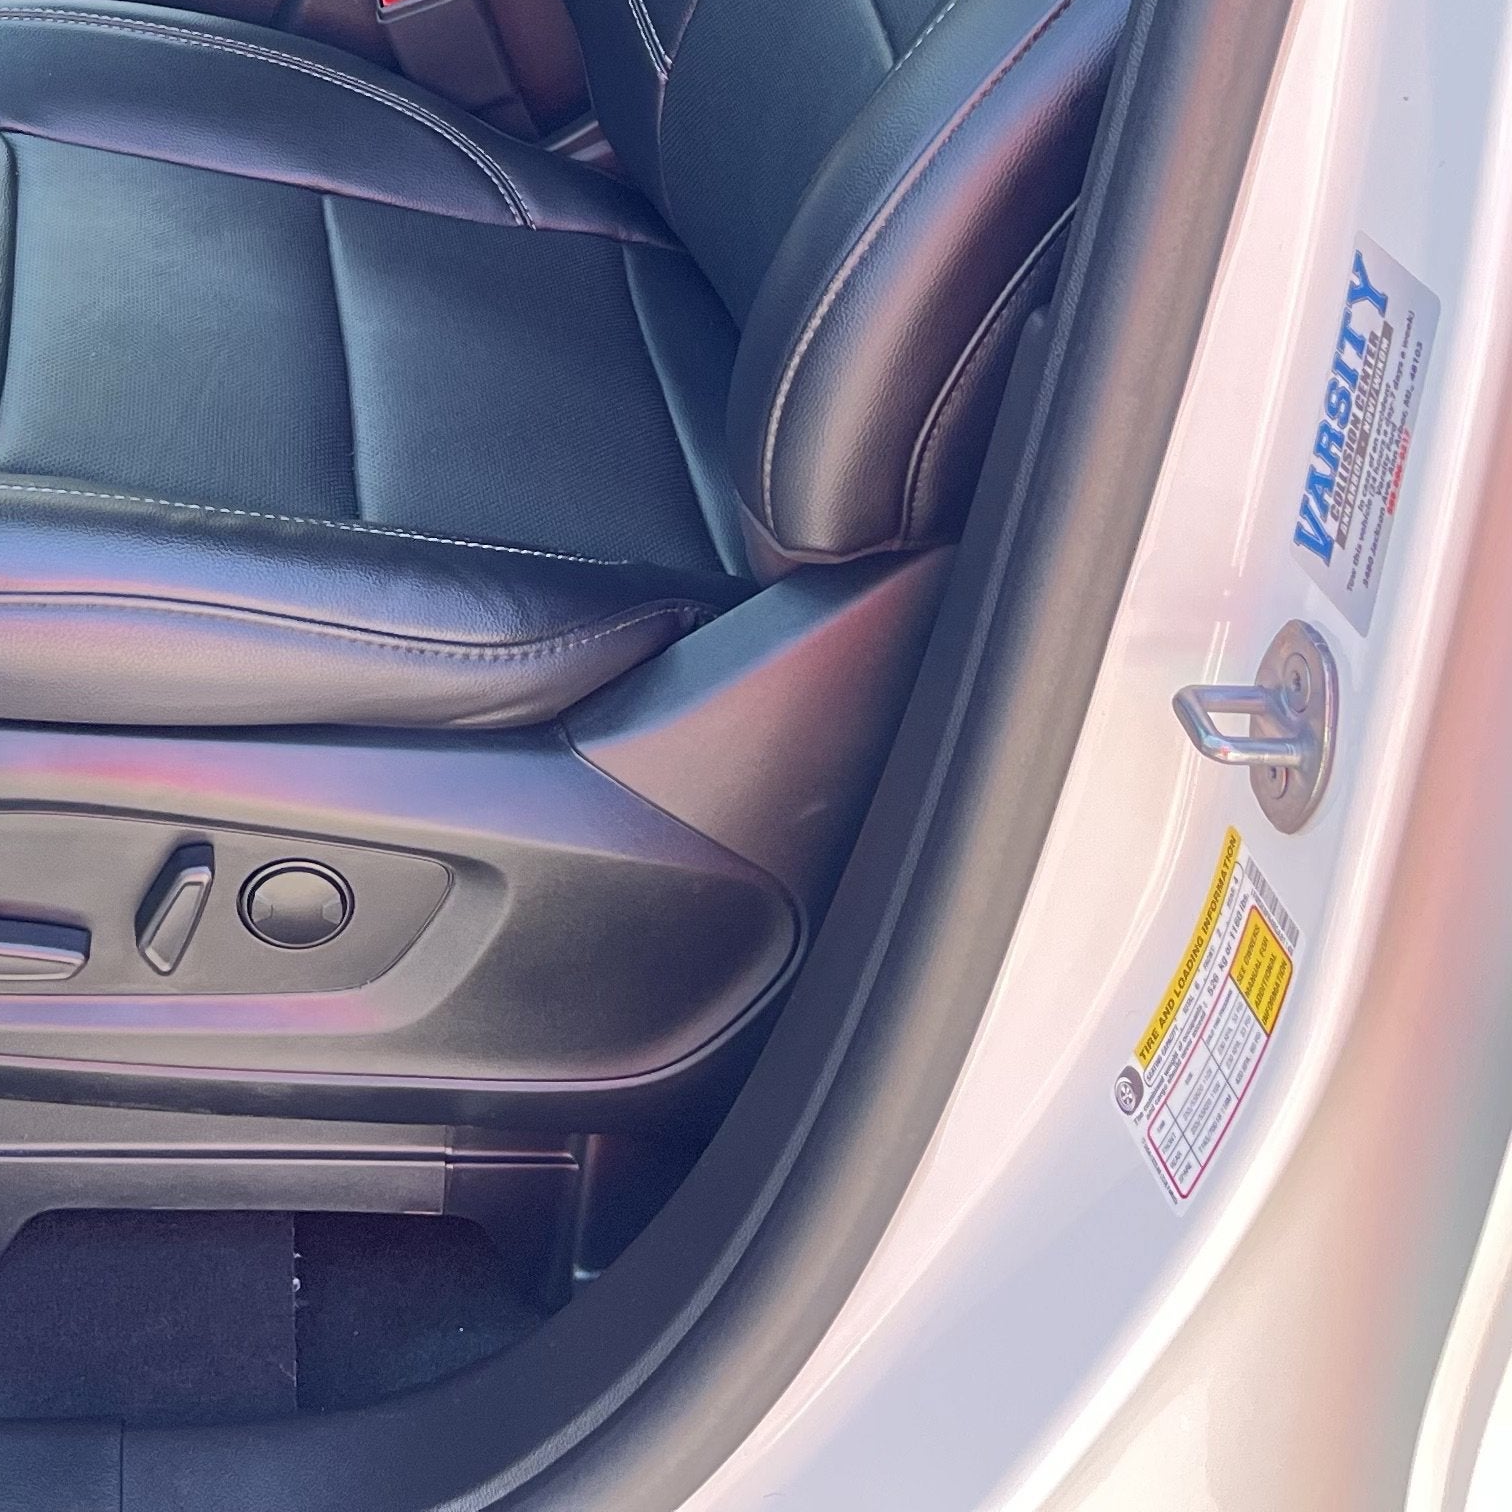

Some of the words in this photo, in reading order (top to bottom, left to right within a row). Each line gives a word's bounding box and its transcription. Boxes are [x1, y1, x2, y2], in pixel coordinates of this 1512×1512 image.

[1293, 249, 1388, 568] VARSITY
[1329, 411, 1361, 522] COLLISION
[1354, 330, 1379, 412] CENTER
[1376, 382, 1390, 436] accident
[1340, 504, 1352, 535] ANN
[1347, 454, 1363, 504] ARBOR
[1139, 1027, 1159, 1060] TIRE
[1158, 998, 1175, 1029] AND
[1173, 935, 1204, 998] LOADING
[1201, 836, 1236, 935] INFORMATION
[1207, 973, 1219, 997] 526
[1217, 955, 1228, 972] kg
[1225, 941, 1232, 956] or
[1244, 958, 1262, 999] MANUAL
[1259, 935, 1269, 958] FOR
[1254, 952, 1277, 1010] ADDITIONAL
[1261, 958, 1287, 1026] INFORMATION
